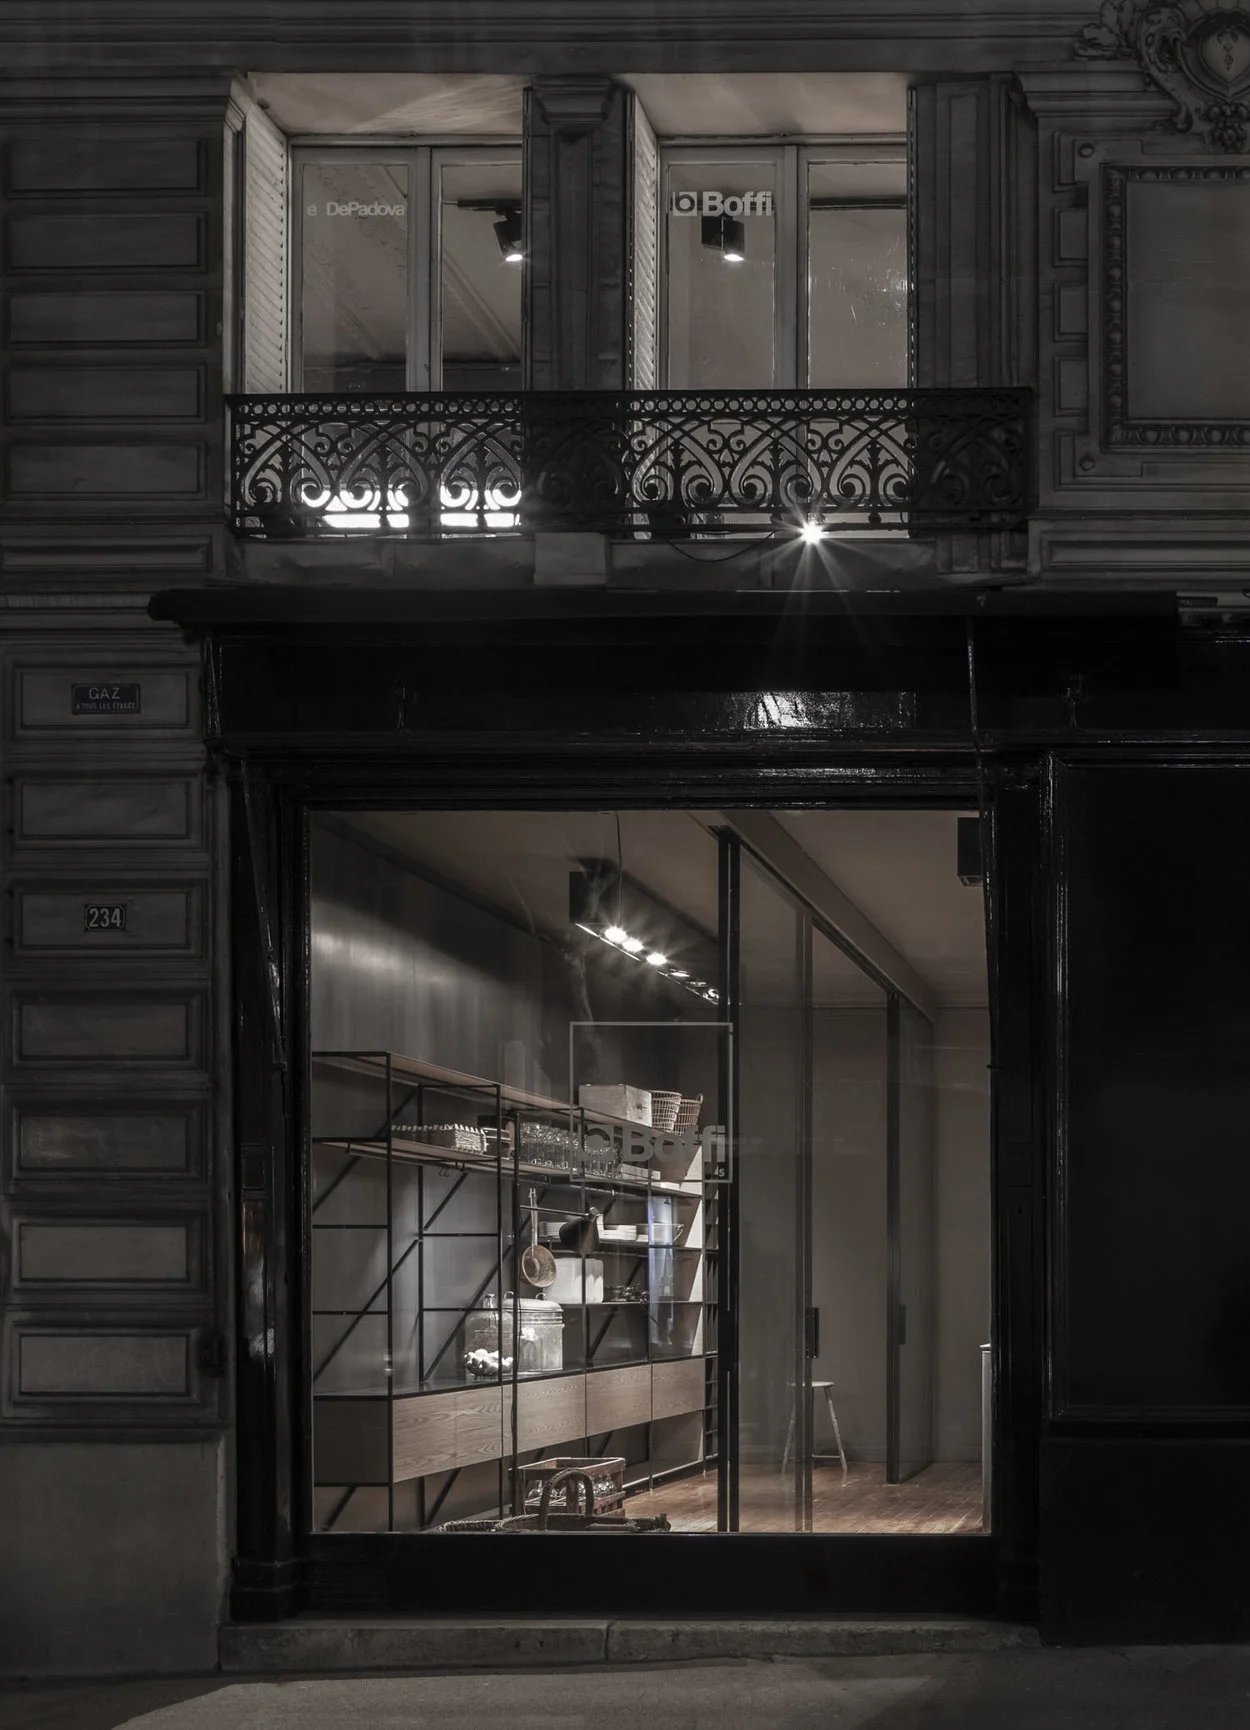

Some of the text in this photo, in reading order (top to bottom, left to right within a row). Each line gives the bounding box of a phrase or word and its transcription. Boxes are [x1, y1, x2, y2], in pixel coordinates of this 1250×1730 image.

[326, 201, 405, 217] DePadova
[703, 191, 772, 217] Boffi
[88, 687, 120, 700] GAZ
[90, 907, 121, 928] 234
[622, 1124, 726, 1163] Boffi
